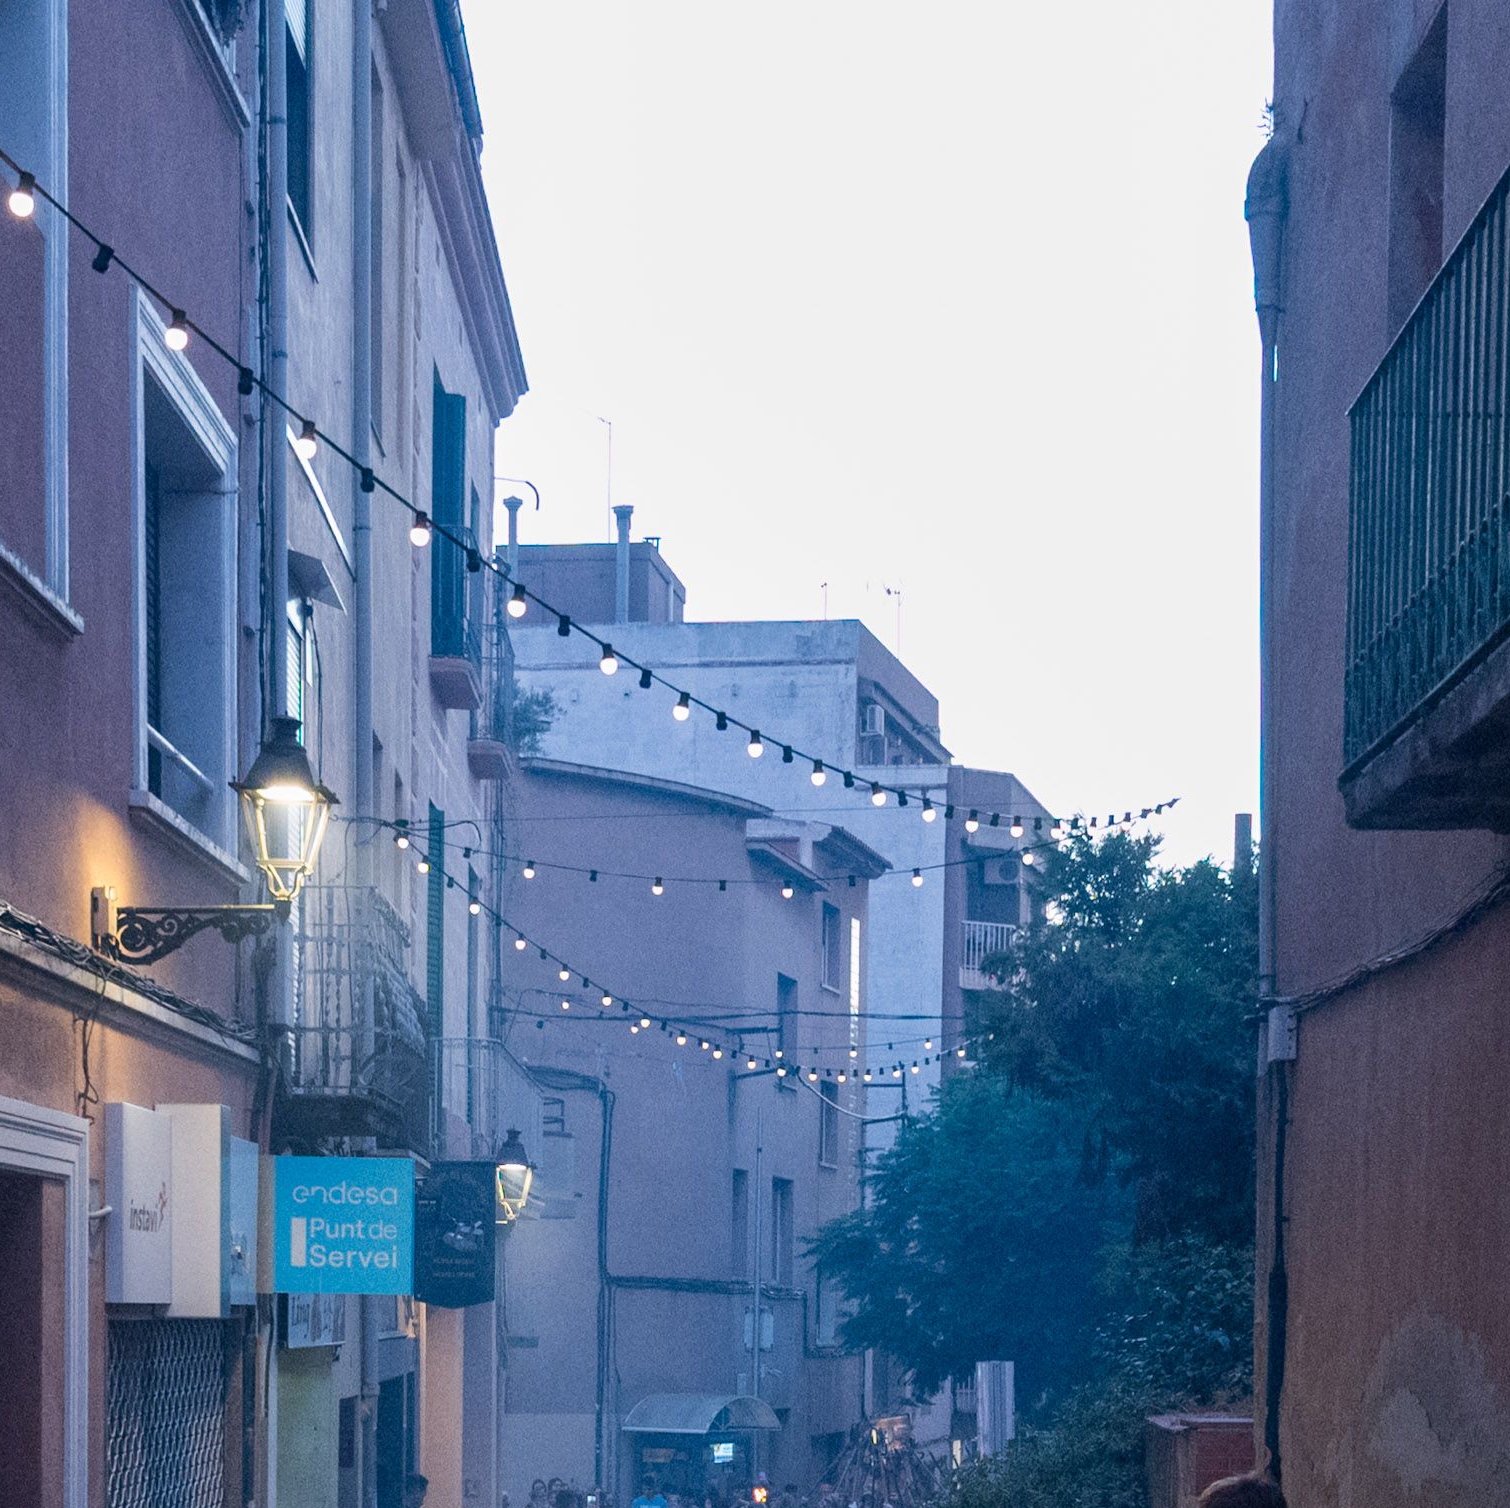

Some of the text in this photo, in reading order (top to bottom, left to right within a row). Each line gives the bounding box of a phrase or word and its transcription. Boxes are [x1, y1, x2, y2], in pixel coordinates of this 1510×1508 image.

[292, 1180, 397, 1204] endesa
[310, 1217, 397, 1239] Punt de
[310, 1244, 397, 1268] Servei
